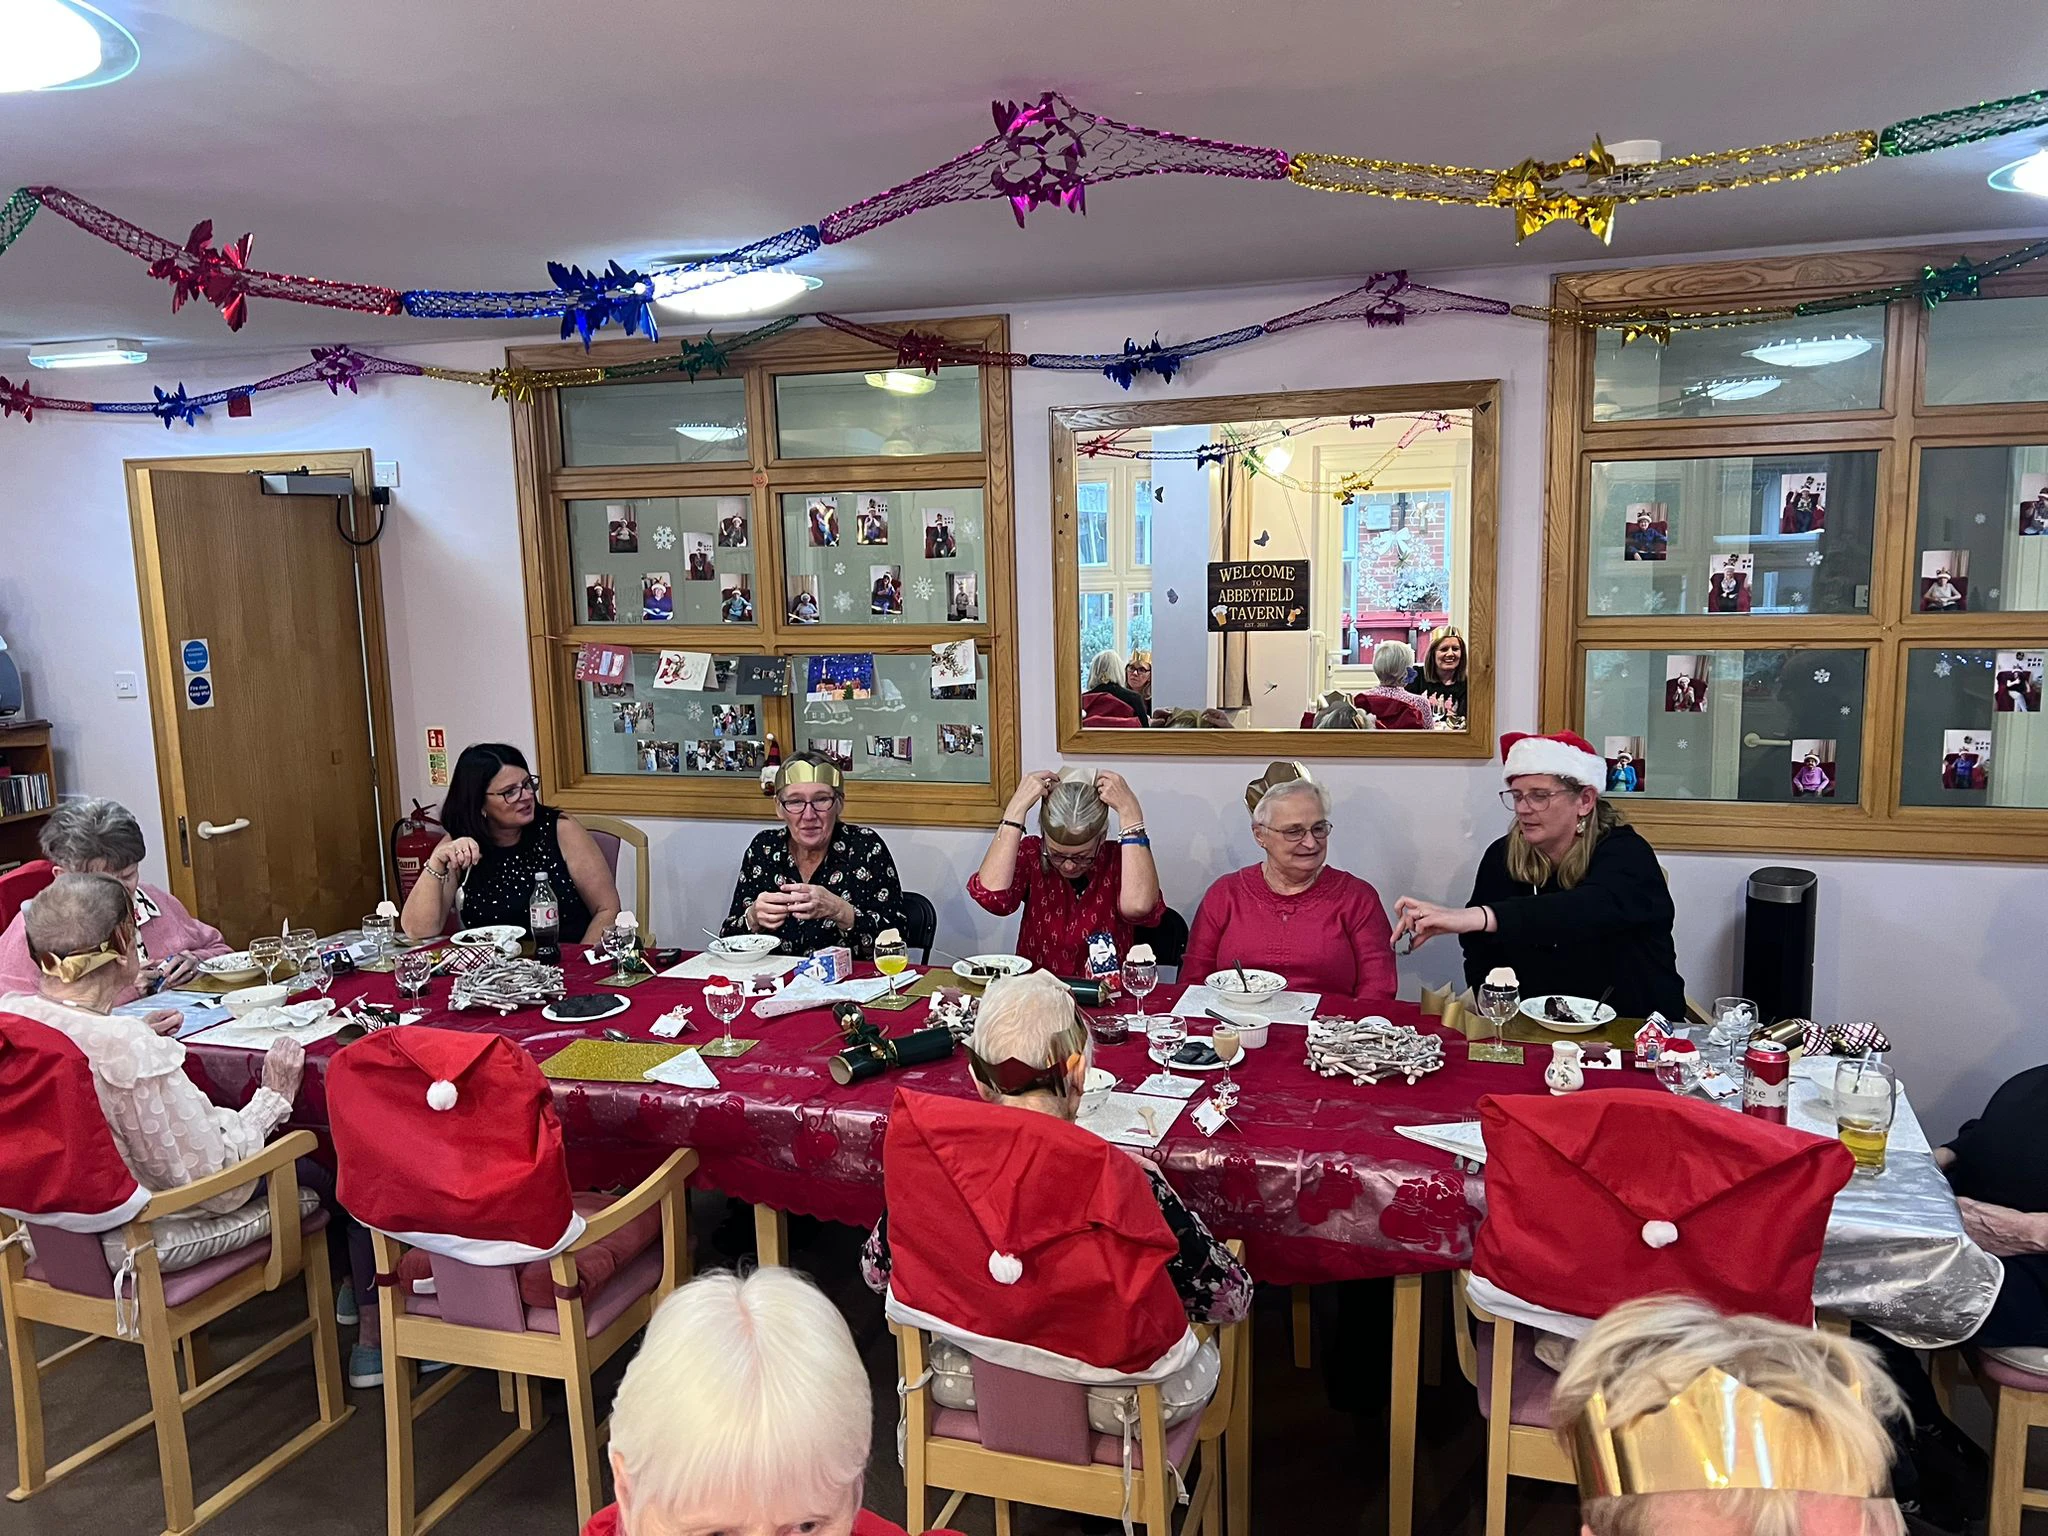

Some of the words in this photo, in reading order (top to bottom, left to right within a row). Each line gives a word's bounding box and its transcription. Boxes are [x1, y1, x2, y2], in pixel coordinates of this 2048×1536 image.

[1219, 564, 1295, 582] WELCOME
[1218, 588, 1294, 602] ABBEYFIELD
[1228, 606, 1285, 620] TAVERN
